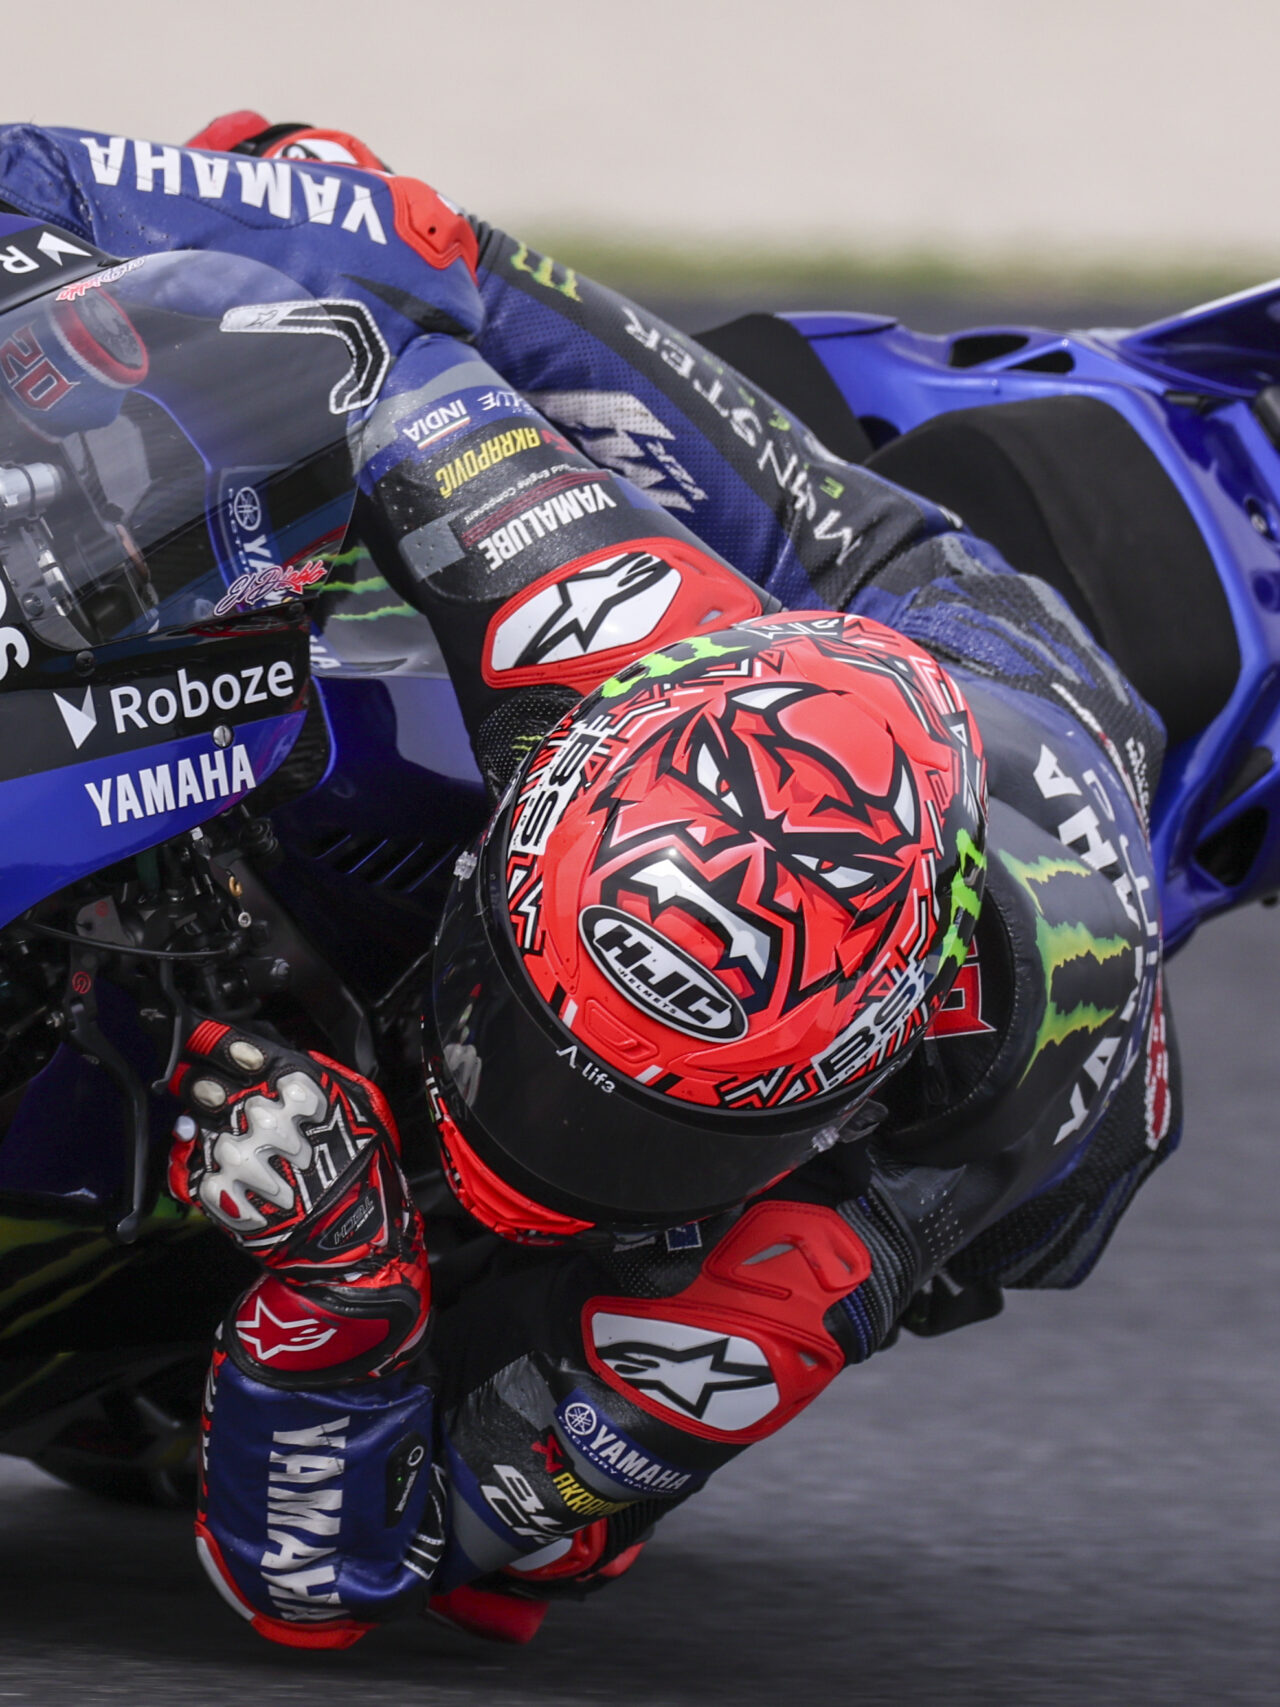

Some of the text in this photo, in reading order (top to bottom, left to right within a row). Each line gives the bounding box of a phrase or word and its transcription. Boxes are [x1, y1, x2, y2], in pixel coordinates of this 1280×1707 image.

[79, 137, 387, 245] YAMAHA
[402, 399, 468, 442] INDIA
[477, 483, 617, 571] YAMALUBE
[109, 660, 295, 734] Roboze
[85, 744, 257, 826] YAMAHA
[595, 924, 732, 1025] HJC
[620, 970, 677, 1015] HELMETS
[818, 974, 918, 1083] BS
[558, 1415, 618, 1475] FACTORY
[589, 1425, 692, 1490] YAMAHA
[260, 1416, 351, 1620] YAMAHA
